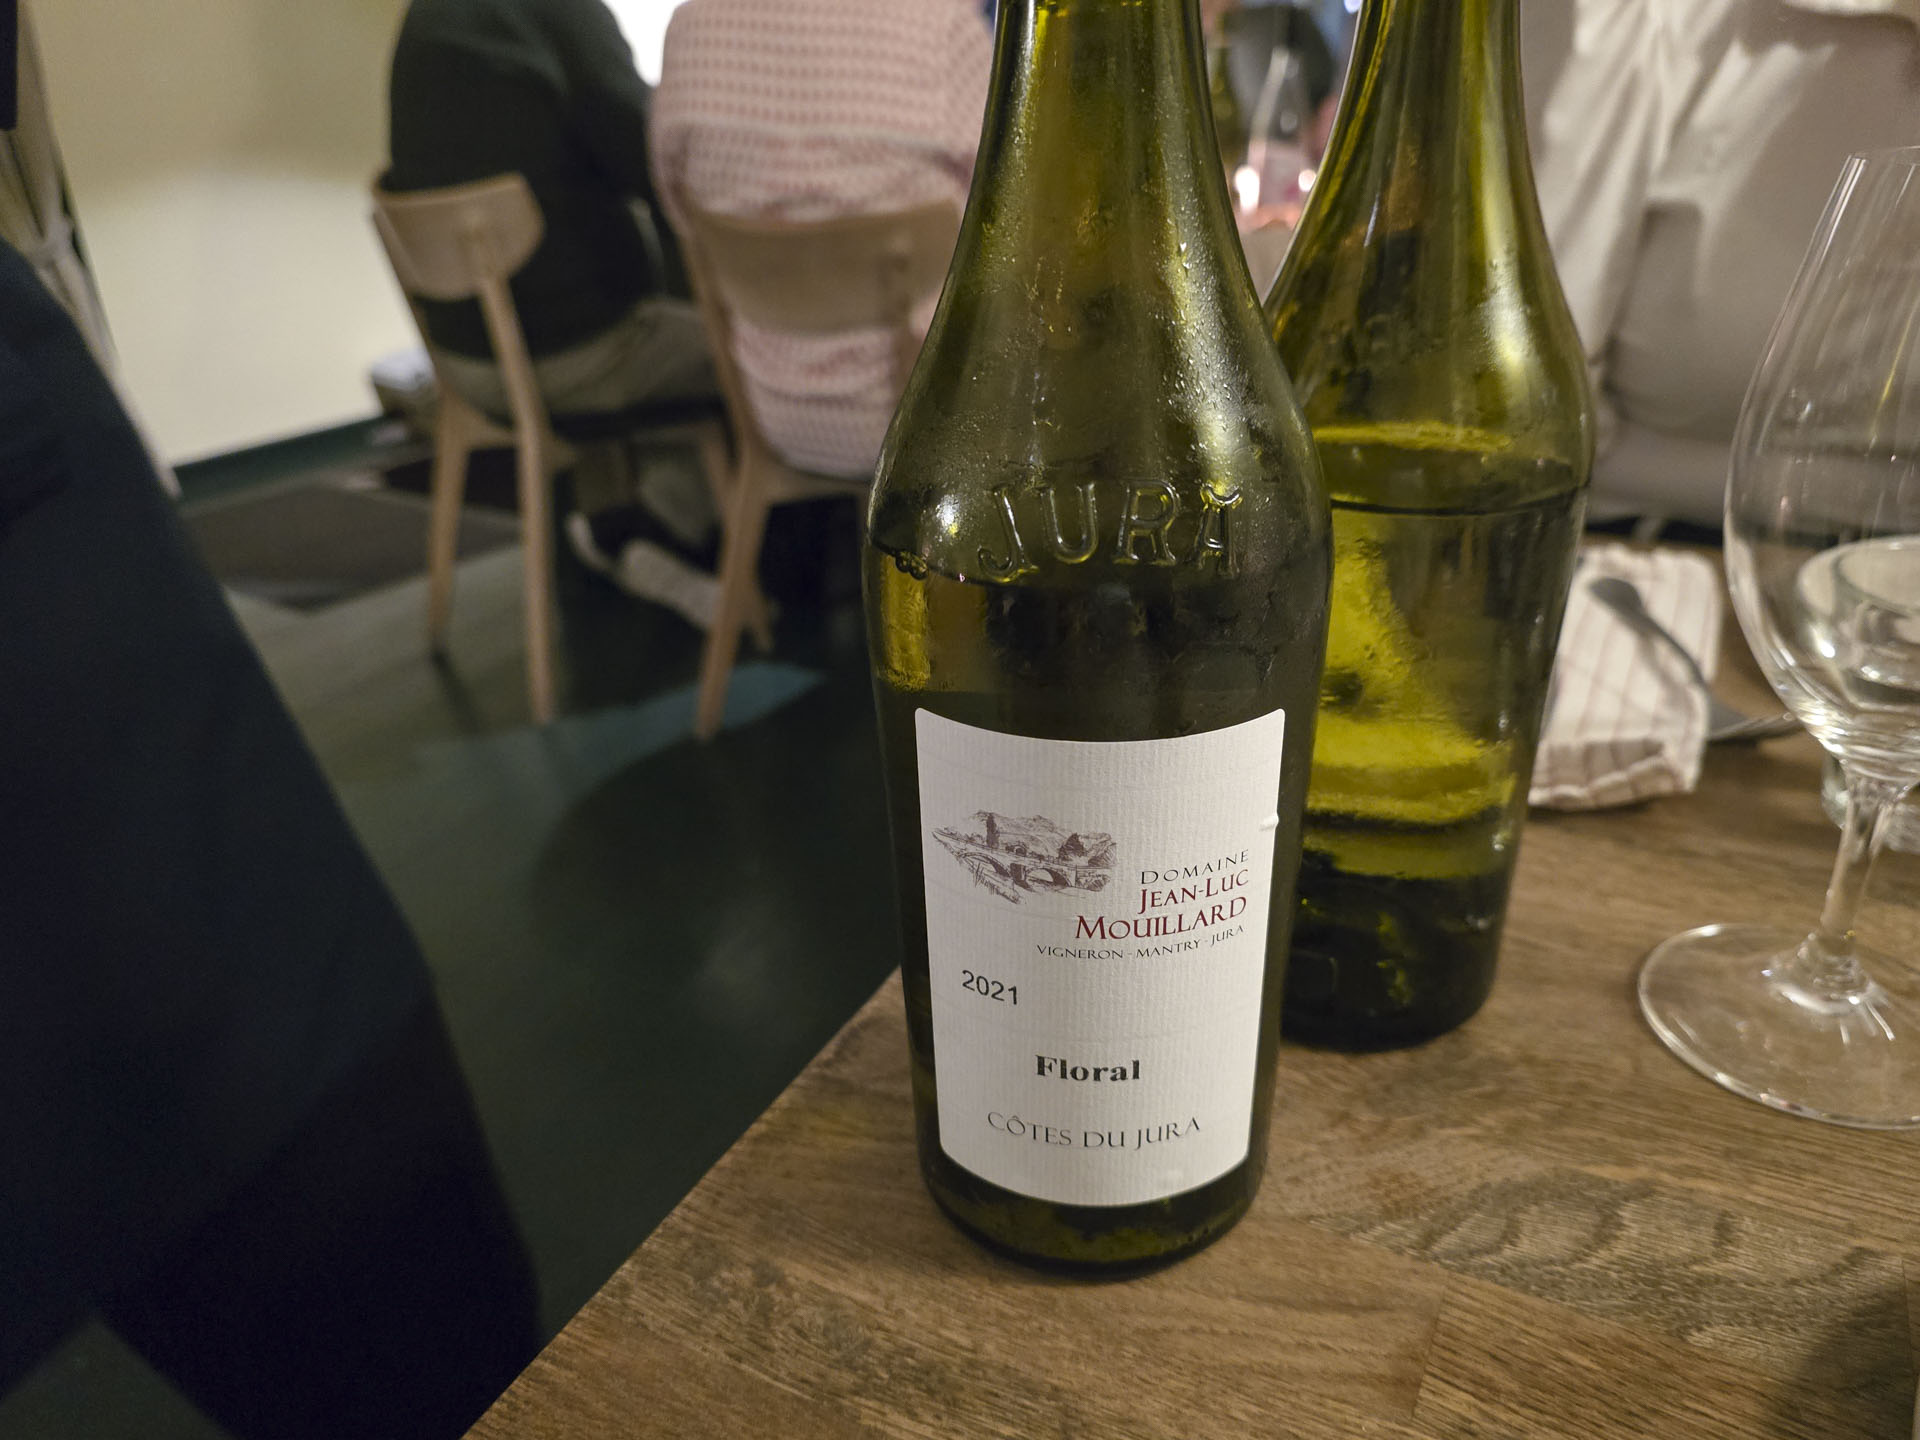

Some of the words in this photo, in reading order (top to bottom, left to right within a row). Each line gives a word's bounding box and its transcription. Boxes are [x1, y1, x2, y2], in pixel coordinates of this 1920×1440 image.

[976, 478, 1243, 584] JURA
[1141, 849, 1249, 885] DOMAINE
[1138, 869, 1249, 915] JEAN-LUC
[1075, 896, 1247, 940] MOUILLARD
[1037, 944, 1124, 960] VIGNERON
[1136, 938, 1200, 960] MANTRY
[1210, 924, 1245, 947] JURA
[961, 969, 1019, 1006] 2021
[1035, 1054, 1141, 1082] Floral
[986, 1111, 1072, 1147] CÔTES
[1083, 1131, 1126, 1149] DU
[1133, 1116, 1201, 1150] JURA
